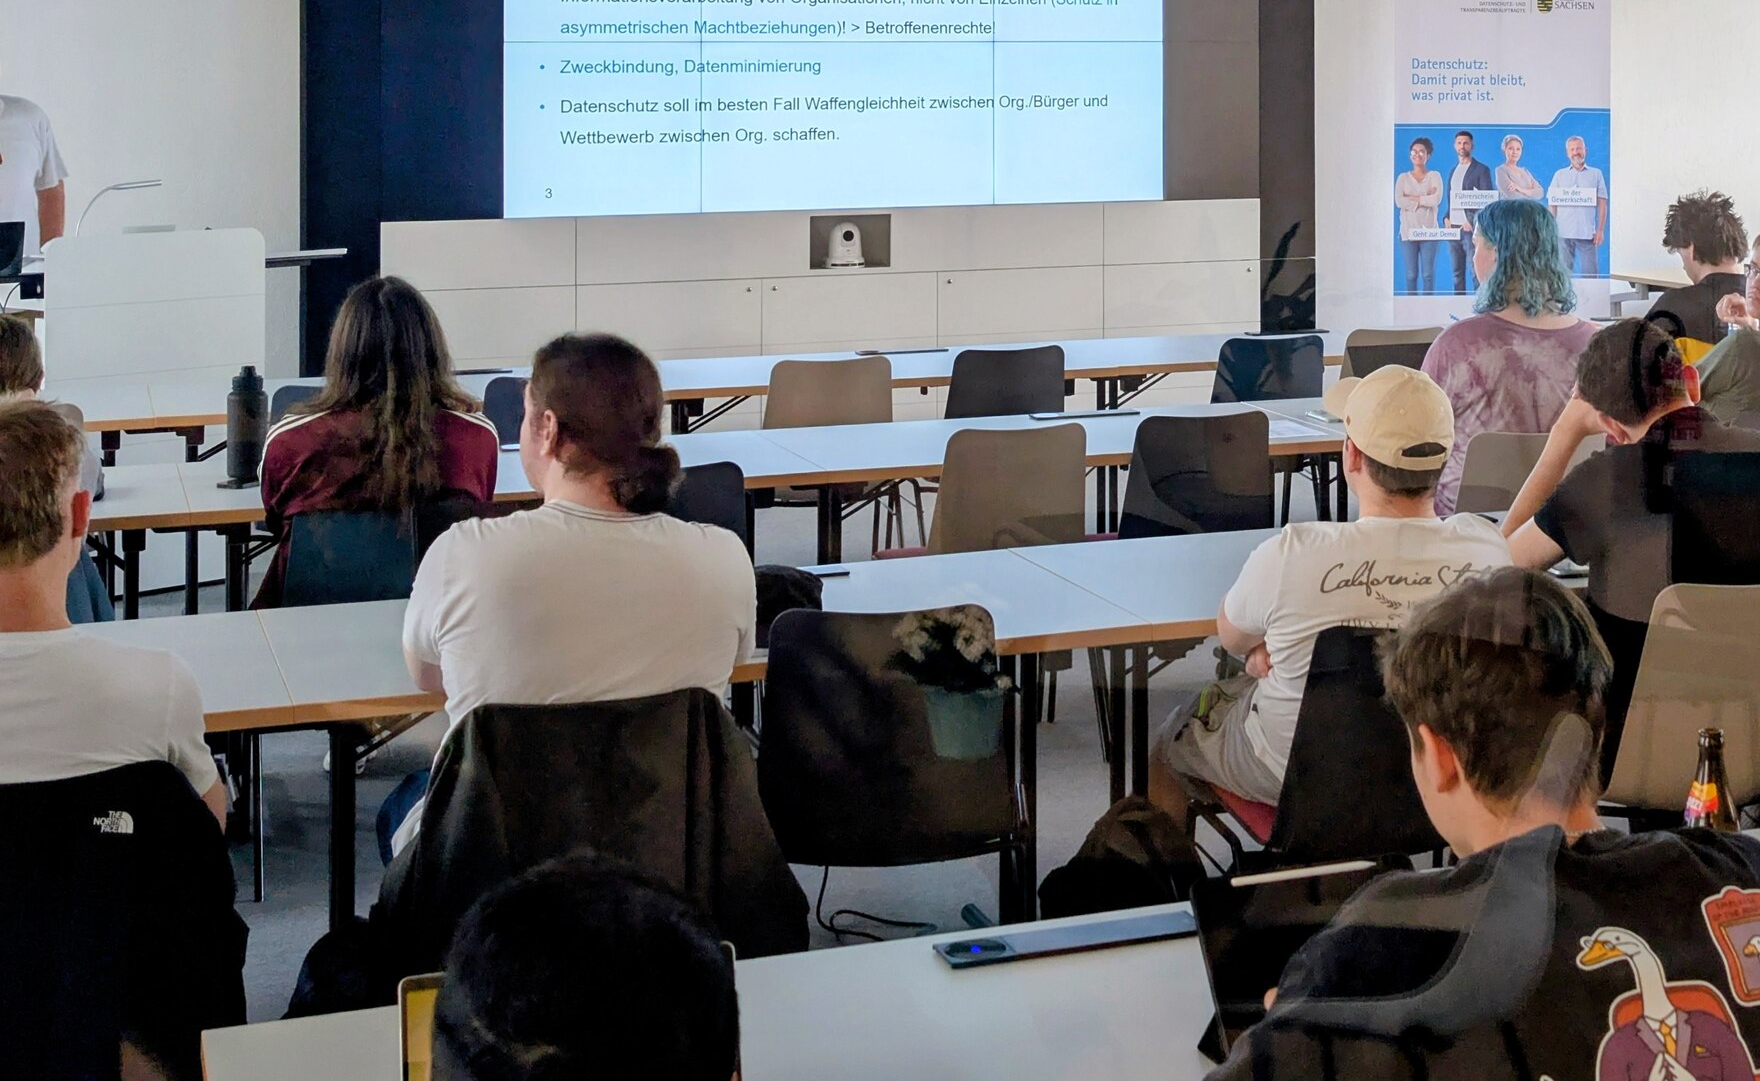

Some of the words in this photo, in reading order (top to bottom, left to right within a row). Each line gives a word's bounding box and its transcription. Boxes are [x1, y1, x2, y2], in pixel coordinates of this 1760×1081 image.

[1555, 1, 1595, 10] SACHSEN
[560, 21, 689, 37] asymmetrischen
[694, 21, 846, 37] Machtbeziehungen)!
[559, 60, 679, 76] Zweckbindung,
[684, 60, 821, 75] Datenminimierung
[1411, 58, 1488, 70] Datenschutz:
[1411, 73, 1447, 85] Damit
[1451, 74, 1485, 88] privat
[1489, 74, 1526, 87] bleibt,
[1411, 91, 1433, 101] was
[1438, 90, 1472, 103] privat
[1476, 90, 1494, 101] ist.
[560, 99, 659, 113] Datenschutz
[663, 99, 690, 111] soll
[694, 99, 712, 111] im
[717, 98, 768, 111] besten
[773, 98, 800, 110] Fall
[804, 97, 926, 112] Waffengleichheit
[929, 96, 994, 108] zwischen
[998, 95, 1080, 110] Org./Bürger
[1083, 95, 1108, 106] und
[559, 130, 655, 144] Wettbewerb
[658, 129, 730, 142] zwischen
[735, 129, 768, 144] Org.
[772, 127, 840, 140] schaffen.
[544, 188, 553, 198] 3
[1413, 230, 1427, 238] Geht
[1440, 230, 1457, 238] Demo
[1320, 560, 1432, 597] California
[108, 810, 122, 818] THE
[93, 817, 120, 825] NORTH
[101, 824, 119, 833] FACE
